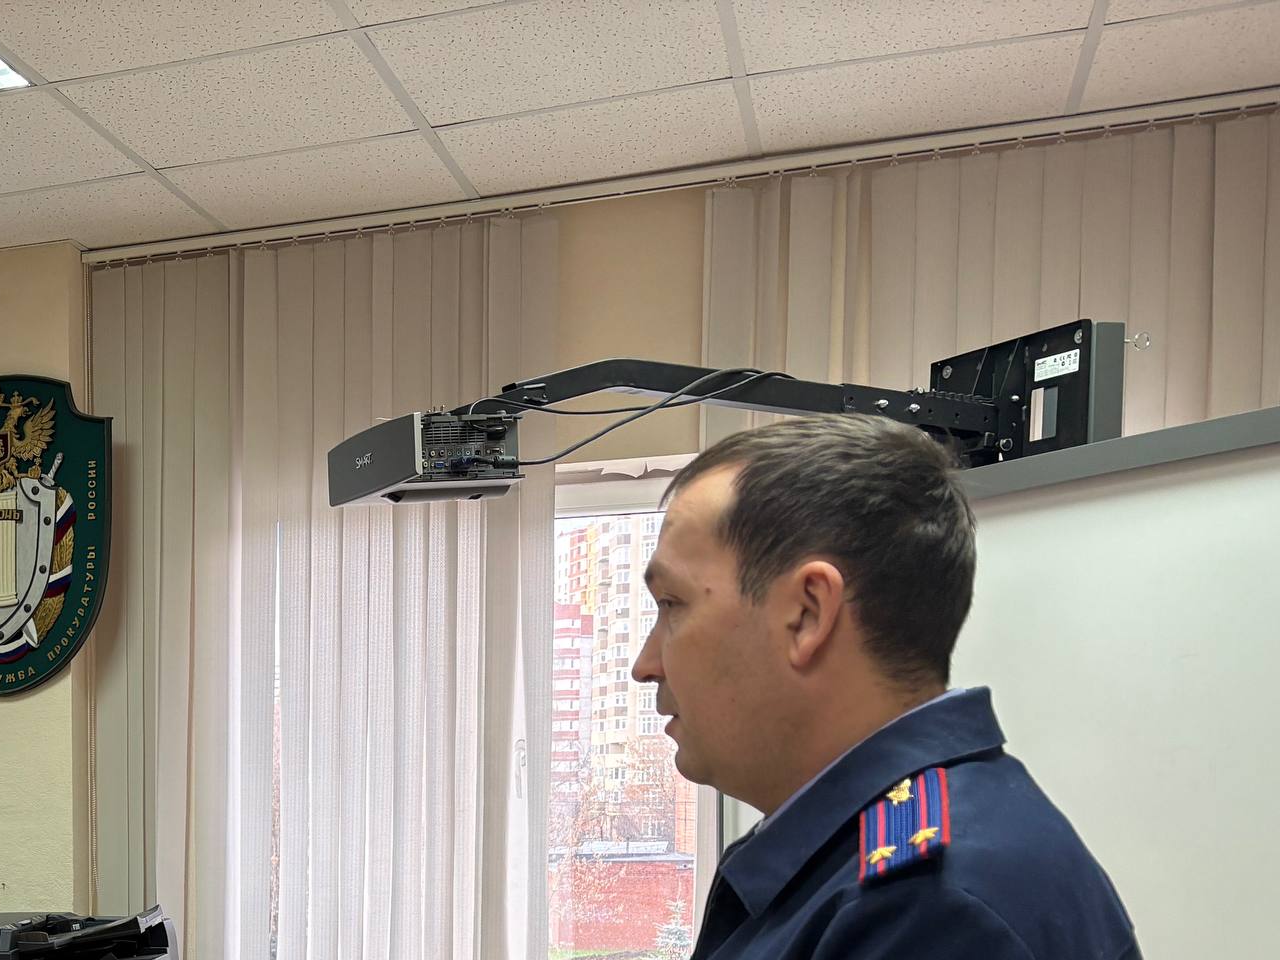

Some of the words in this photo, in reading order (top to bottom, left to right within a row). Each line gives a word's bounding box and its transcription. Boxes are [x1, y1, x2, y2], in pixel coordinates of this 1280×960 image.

[355, 452, 372, 469] SMART
[47, 545, 97, 662] ПРОКУРАТУРЫ
[87, 459, 98, 521] РОССИИ
